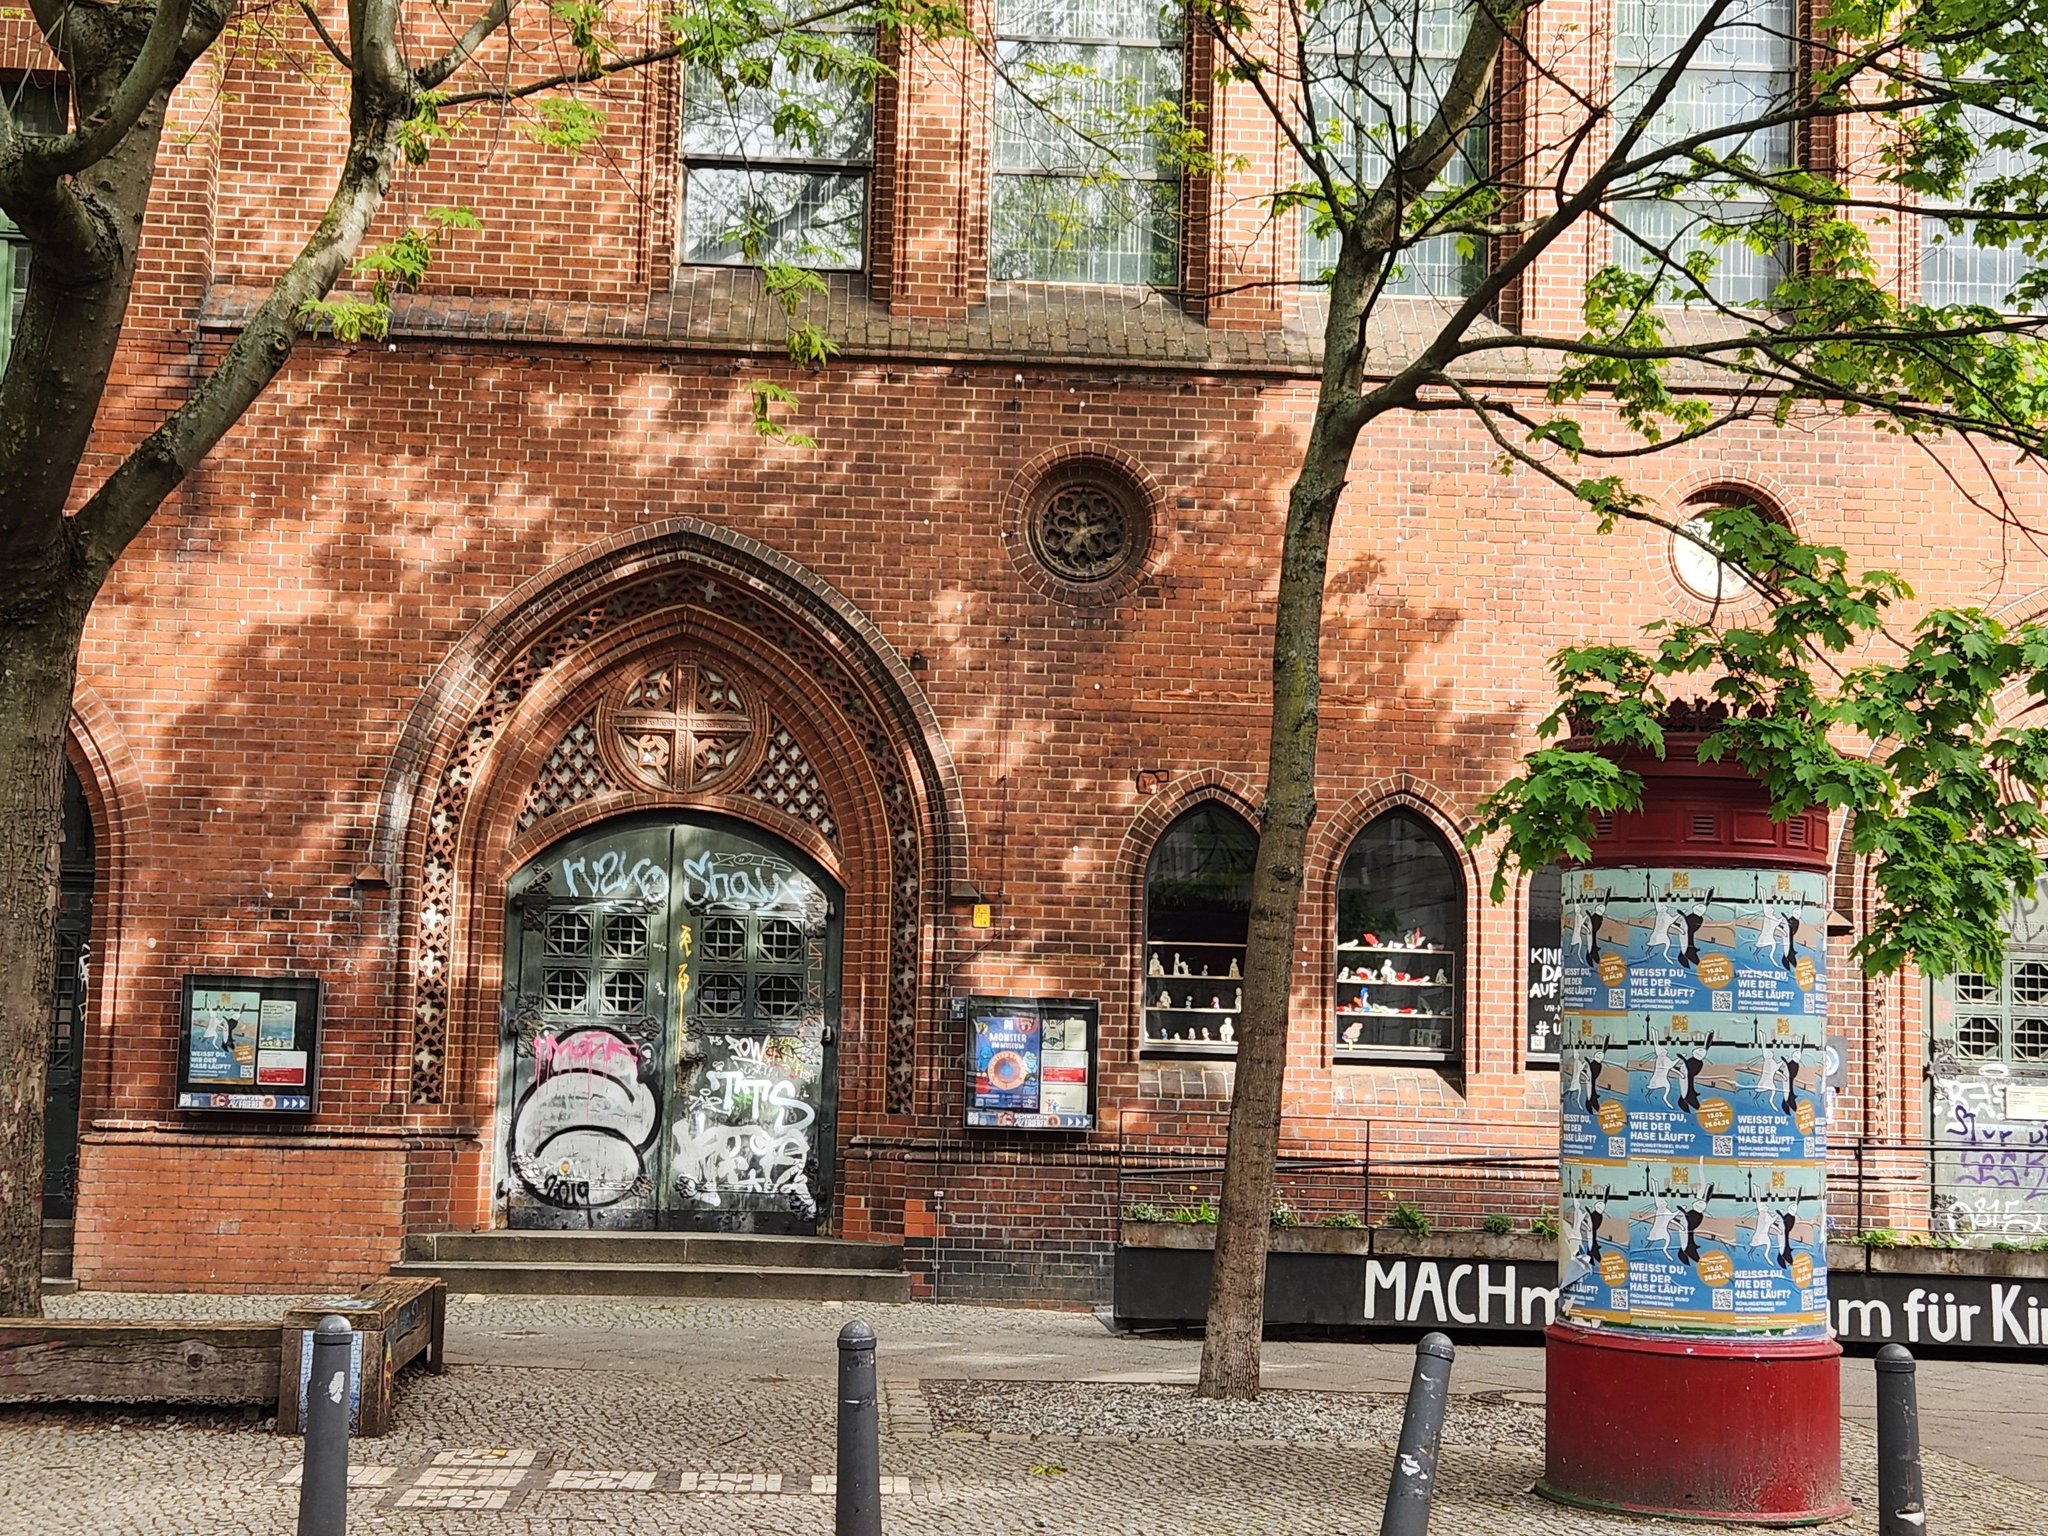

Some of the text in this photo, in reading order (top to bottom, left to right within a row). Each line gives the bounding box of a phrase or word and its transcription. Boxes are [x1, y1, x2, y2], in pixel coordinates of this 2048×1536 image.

[1630, 968, 1687, 978] WEISST DU,
[1775, 971, 1788, 981] DU,
[1630, 978, 1671, 987] WIE DER
[1738, 980, 1777, 989] WIE DER
[1529, 982, 1558, 998] AUF
[1575, 986, 1597, 995] LÄUFT?
[1630, 987, 1695, 997] HASE LÄUFT?
[1738, 989, 1795, 1000] HASE LÄUFT?
[989, 1032, 1026, 1043] MONSTER
[1630, 1112, 1687, 1123] WEISST DU,
[1738, 1115, 1788, 1126] WEISST DU,
[1630, 1122, 1671, 1131] WIE DER
[1738, 1126, 1777, 1134] WIE DER
[1575, 1133, 1596, 1143] LÄUFT?
[1630, 1132, 1696, 1142] HASE LÄUFT?
[1738, 1135, 1795, 1145] HASE LÄUFT?
[1630, 1262, 1687, 1276] WEISST DU,
[1630, 1273, 1671, 1283] WIE DER
[1630, 1283, 1696, 1295] HASE LÄUFT?
[1753, 1280, 1772, 1288] DER
[1760, 1289, 1791, 1299] LÄUFT?
[1903, 1288, 1981, 1343] für
